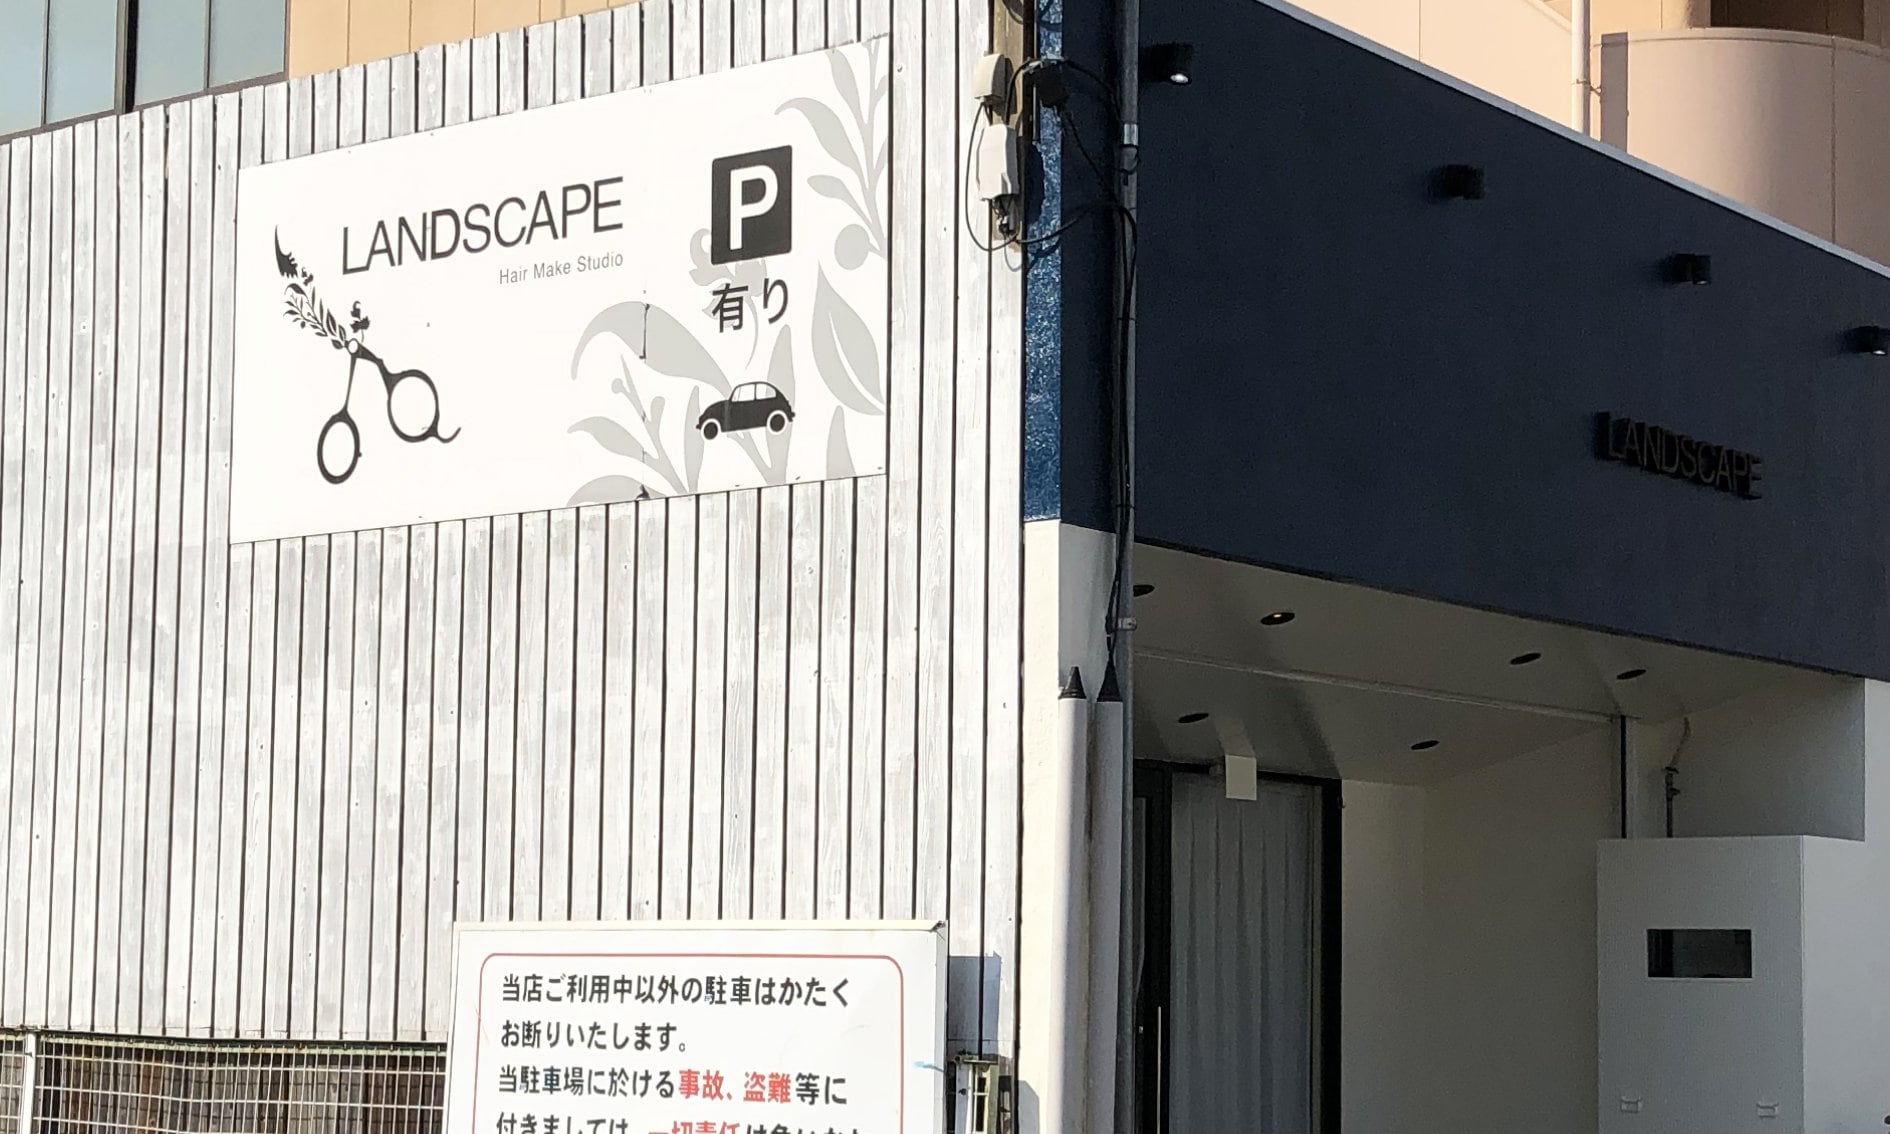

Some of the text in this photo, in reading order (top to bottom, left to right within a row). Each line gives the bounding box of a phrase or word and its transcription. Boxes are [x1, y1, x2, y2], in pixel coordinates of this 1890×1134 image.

[342, 176, 623, 275] LANDSCAPE
[730, 164, 779, 251] P
[499, 252, 623, 284] Hair Make Studio
[711, 277, 788, 333] 有り
[1598, 412, 1763, 499] LANDSCAPE
[502, 973, 849, 1008] 当店ご利用中以外の駐車はかたく
[501, 1019, 686, 1052] お断りいたします。
[498, 1064, 848, 1106] 当駐車場に於ける事故、盗難等に
